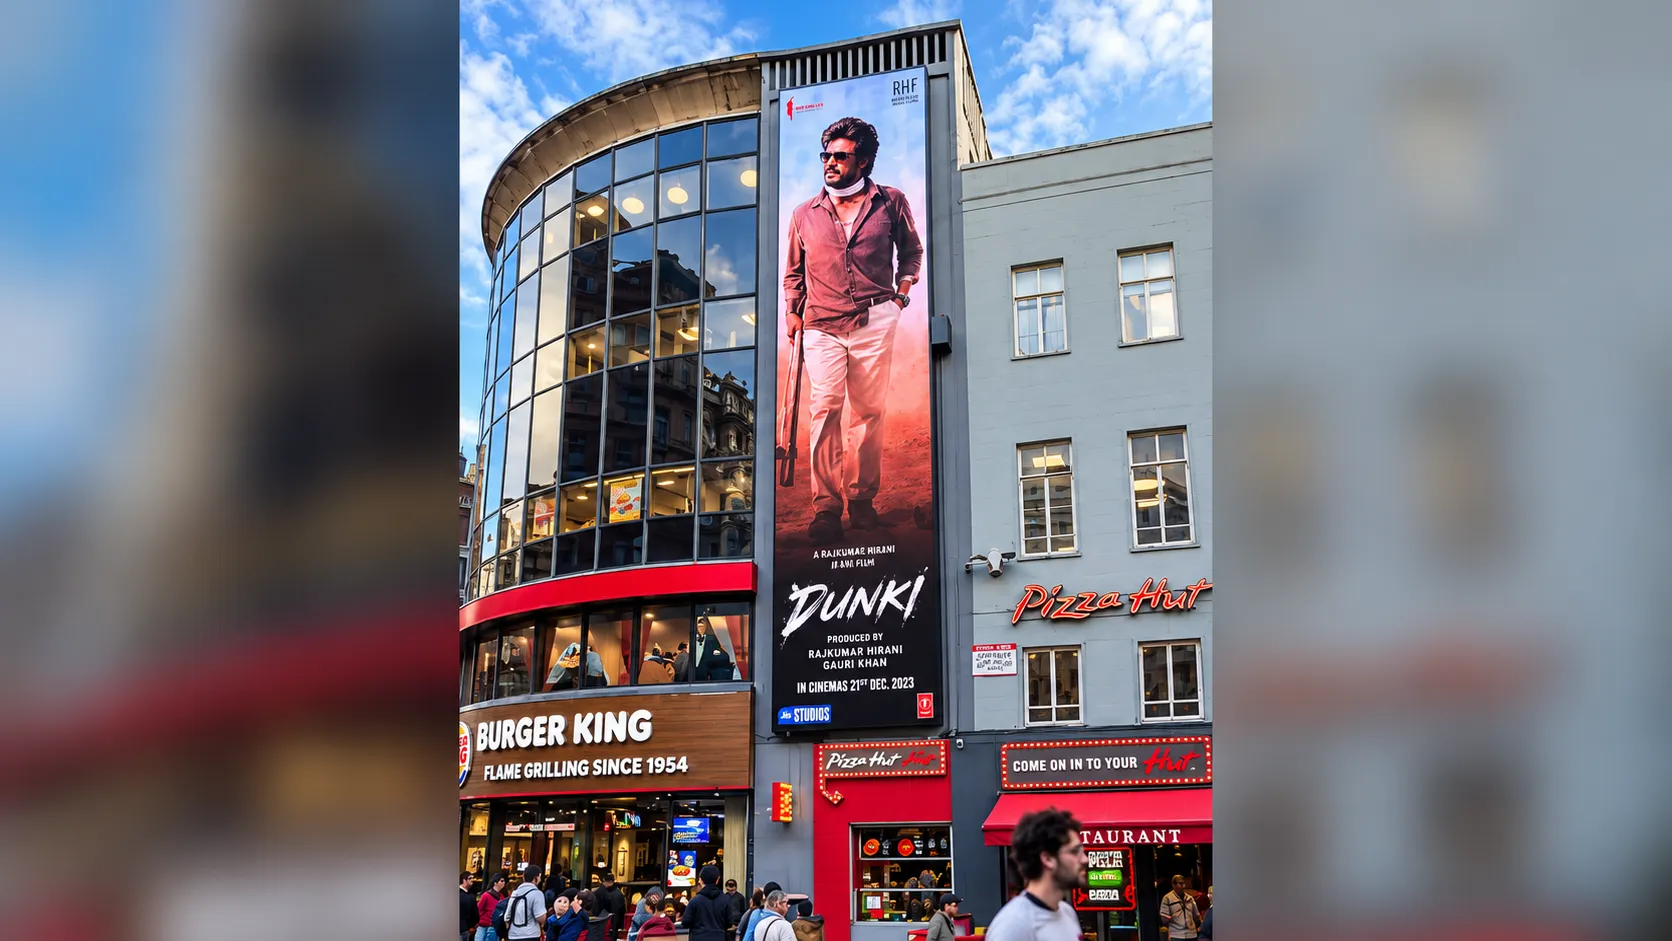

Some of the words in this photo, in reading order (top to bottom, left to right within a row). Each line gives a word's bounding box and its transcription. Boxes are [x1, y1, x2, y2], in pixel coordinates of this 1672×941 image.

[893, 77, 918, 96] RHF
[781, 571, 927, 638] DUNKI
[1011, 583, 1123, 625] Pizza
[1128, 577, 1213, 615] Hut
[827, 634, 870, 644] PRODUCED
[873, 633, 884, 641] BY
[808, 647, 864, 659] RAJKUMAR
[867, 645, 903, 655] HIRANI
[823, 660, 855, 670] GAURI
[858, 658, 887, 668] KHAN
[797, 682, 806, 694] IN
[808, 680, 848, 693] CINEMAS
[870, 677, 890, 690] DEC.
[892, 676, 915, 689] 2023
[793, 706, 830, 722] STUDIOS
[476, 714, 566, 751] BURGER
[573, 709, 653, 745] KING
[483, 763, 522, 781] FLAME
[524, 759, 589, 779] GRILLING
[592, 757, 643, 776] SINCE
[646, 756, 688, 773] 1954
[825, 752, 867, 770] Pizza
[868, 751, 902, 767] Hut
[1013, 760, 1047, 773] COME
[1050, 758, 1066, 772] ON
[1070, 758, 1083, 771] IN
[1085, 757, 1102, 770] TO
[1104, 756, 1138, 770] YOUR
[1080, 829, 1181, 845] TAURANT
